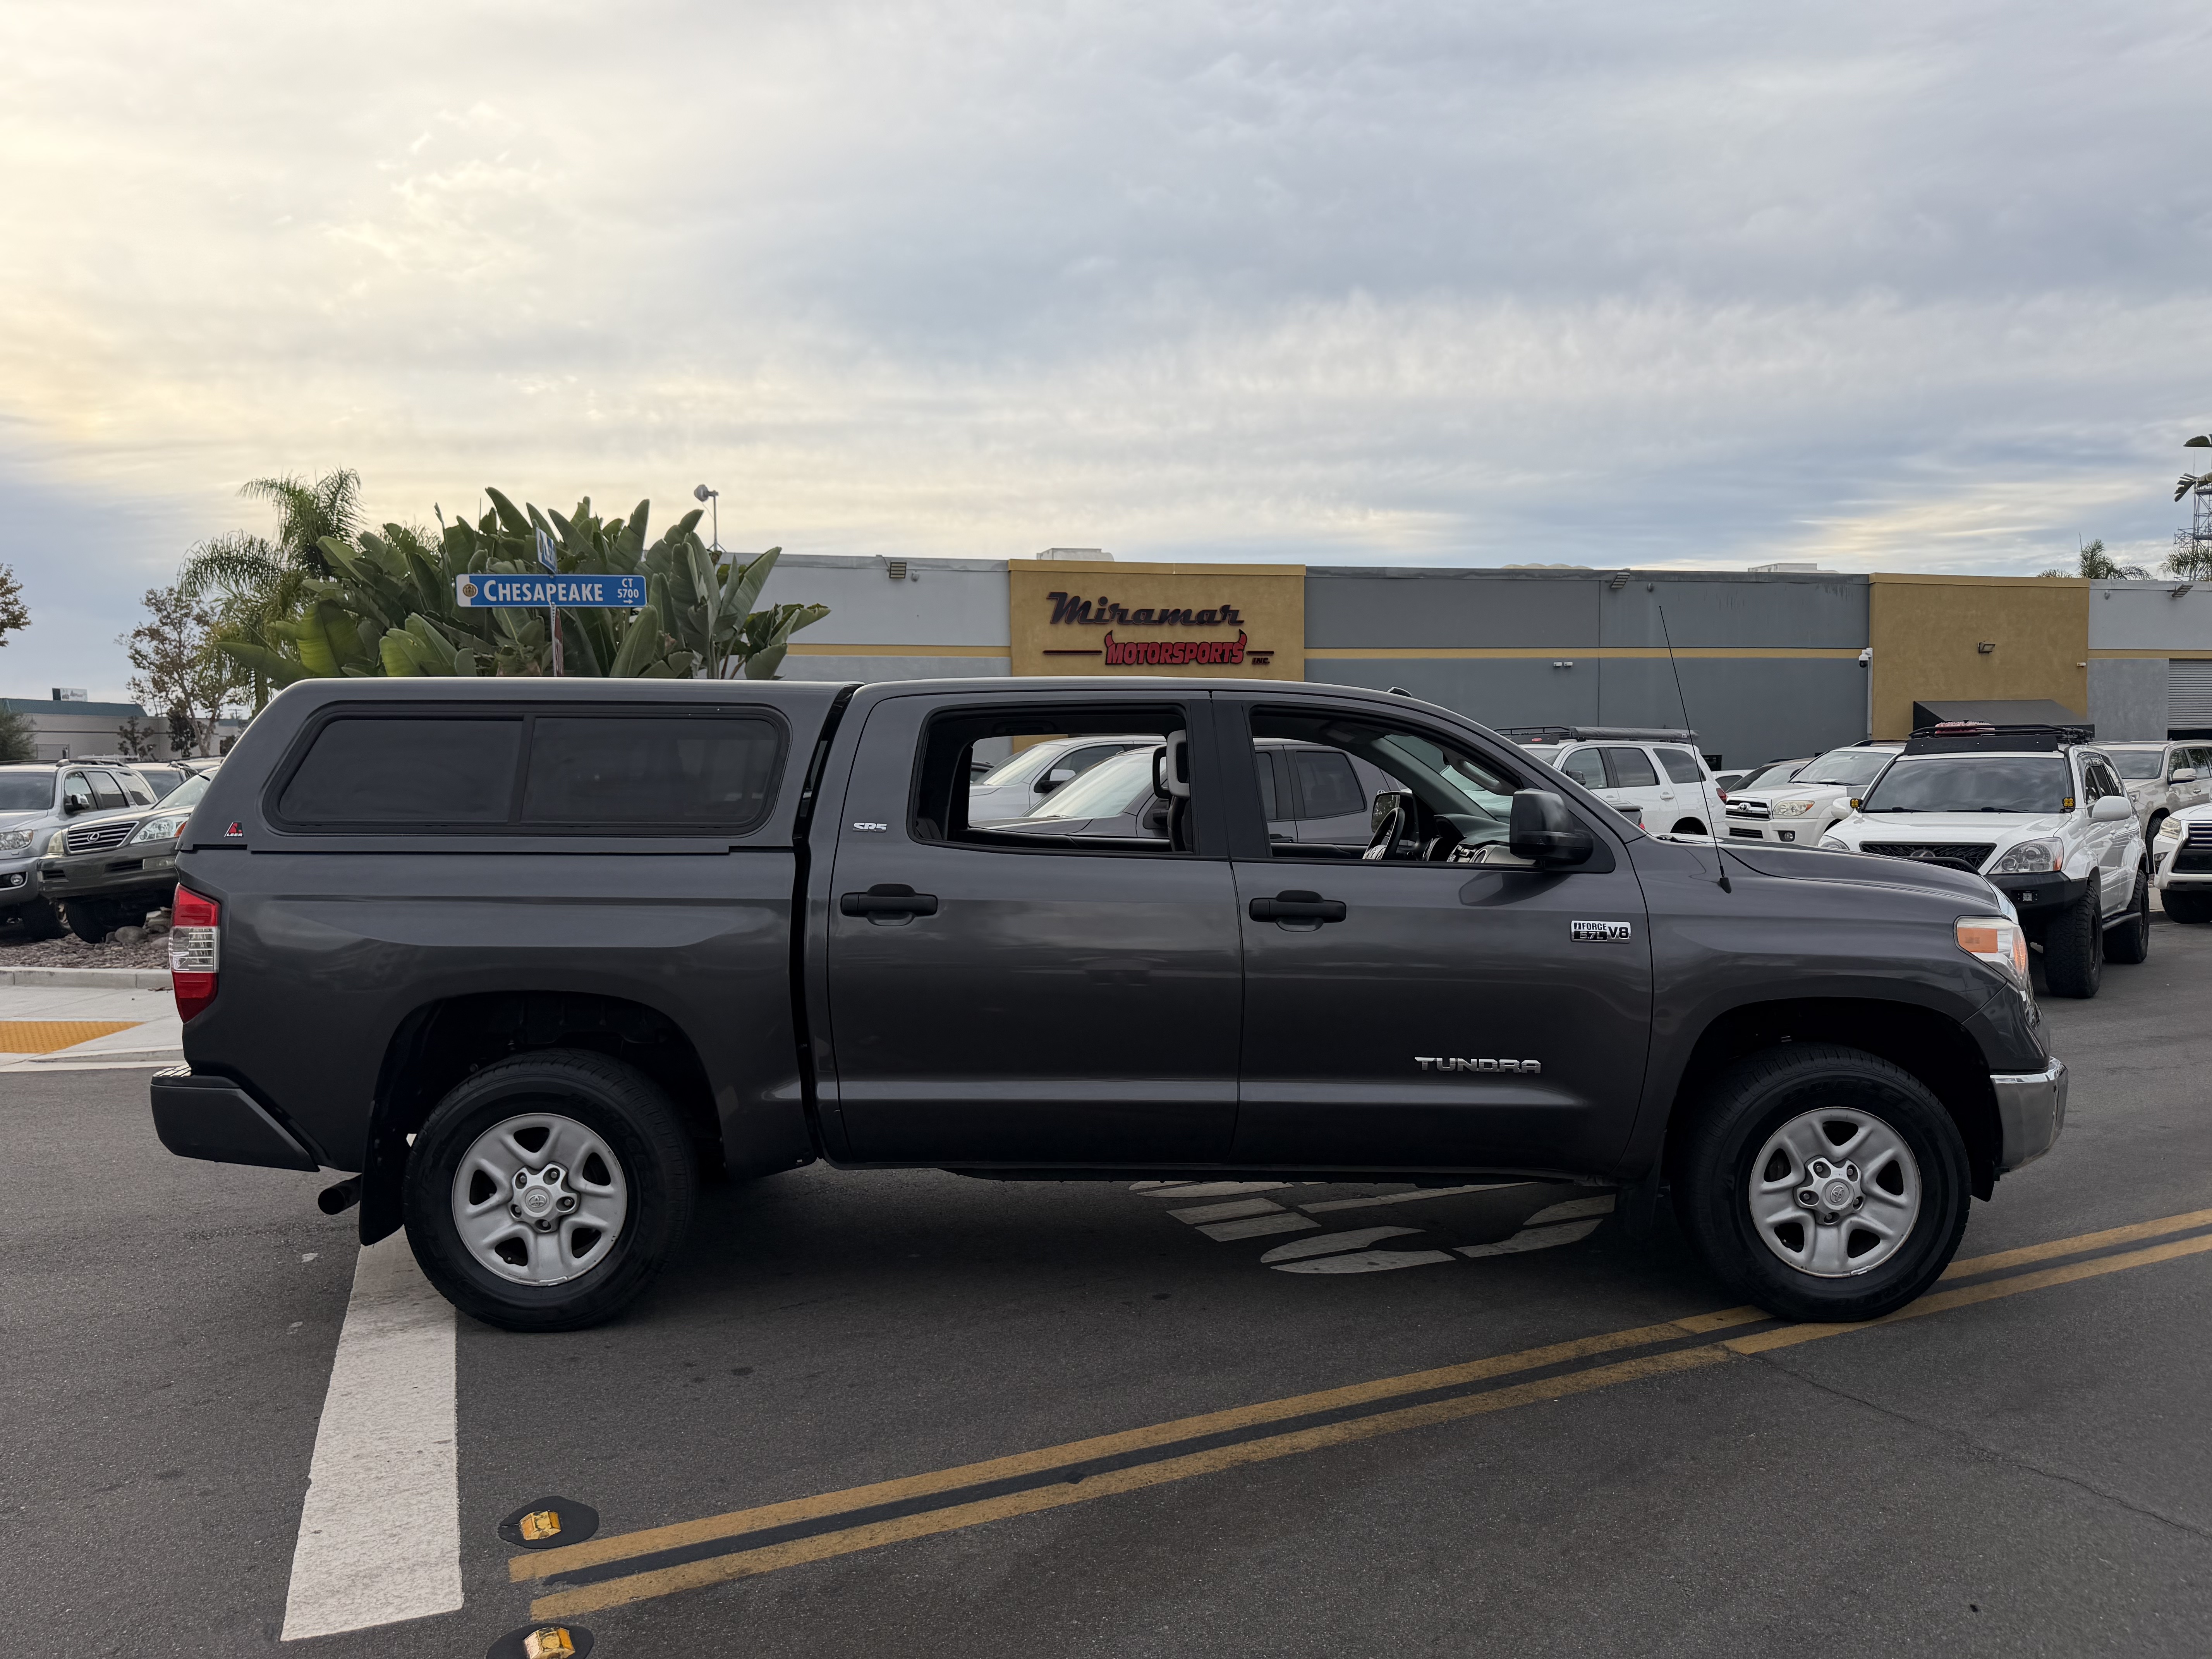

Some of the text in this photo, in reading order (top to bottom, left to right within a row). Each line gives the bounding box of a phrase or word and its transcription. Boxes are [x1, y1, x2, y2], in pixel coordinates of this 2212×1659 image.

[622, 578, 632, 587] CT
[483, 580, 603, 601] CHESAPEAKE
[617, 588, 639, 599] 5700
[1047, 591, 1245, 626] Miramar
[1105, 641, 1245, 665] MOTORSPORTS
[853, 823, 887, 832] SR5
[1580, 931, 1604, 940] 5.7L
[1607, 926, 1629, 939] V8
[1414, 1056, 1541, 1074] TUNDRA
